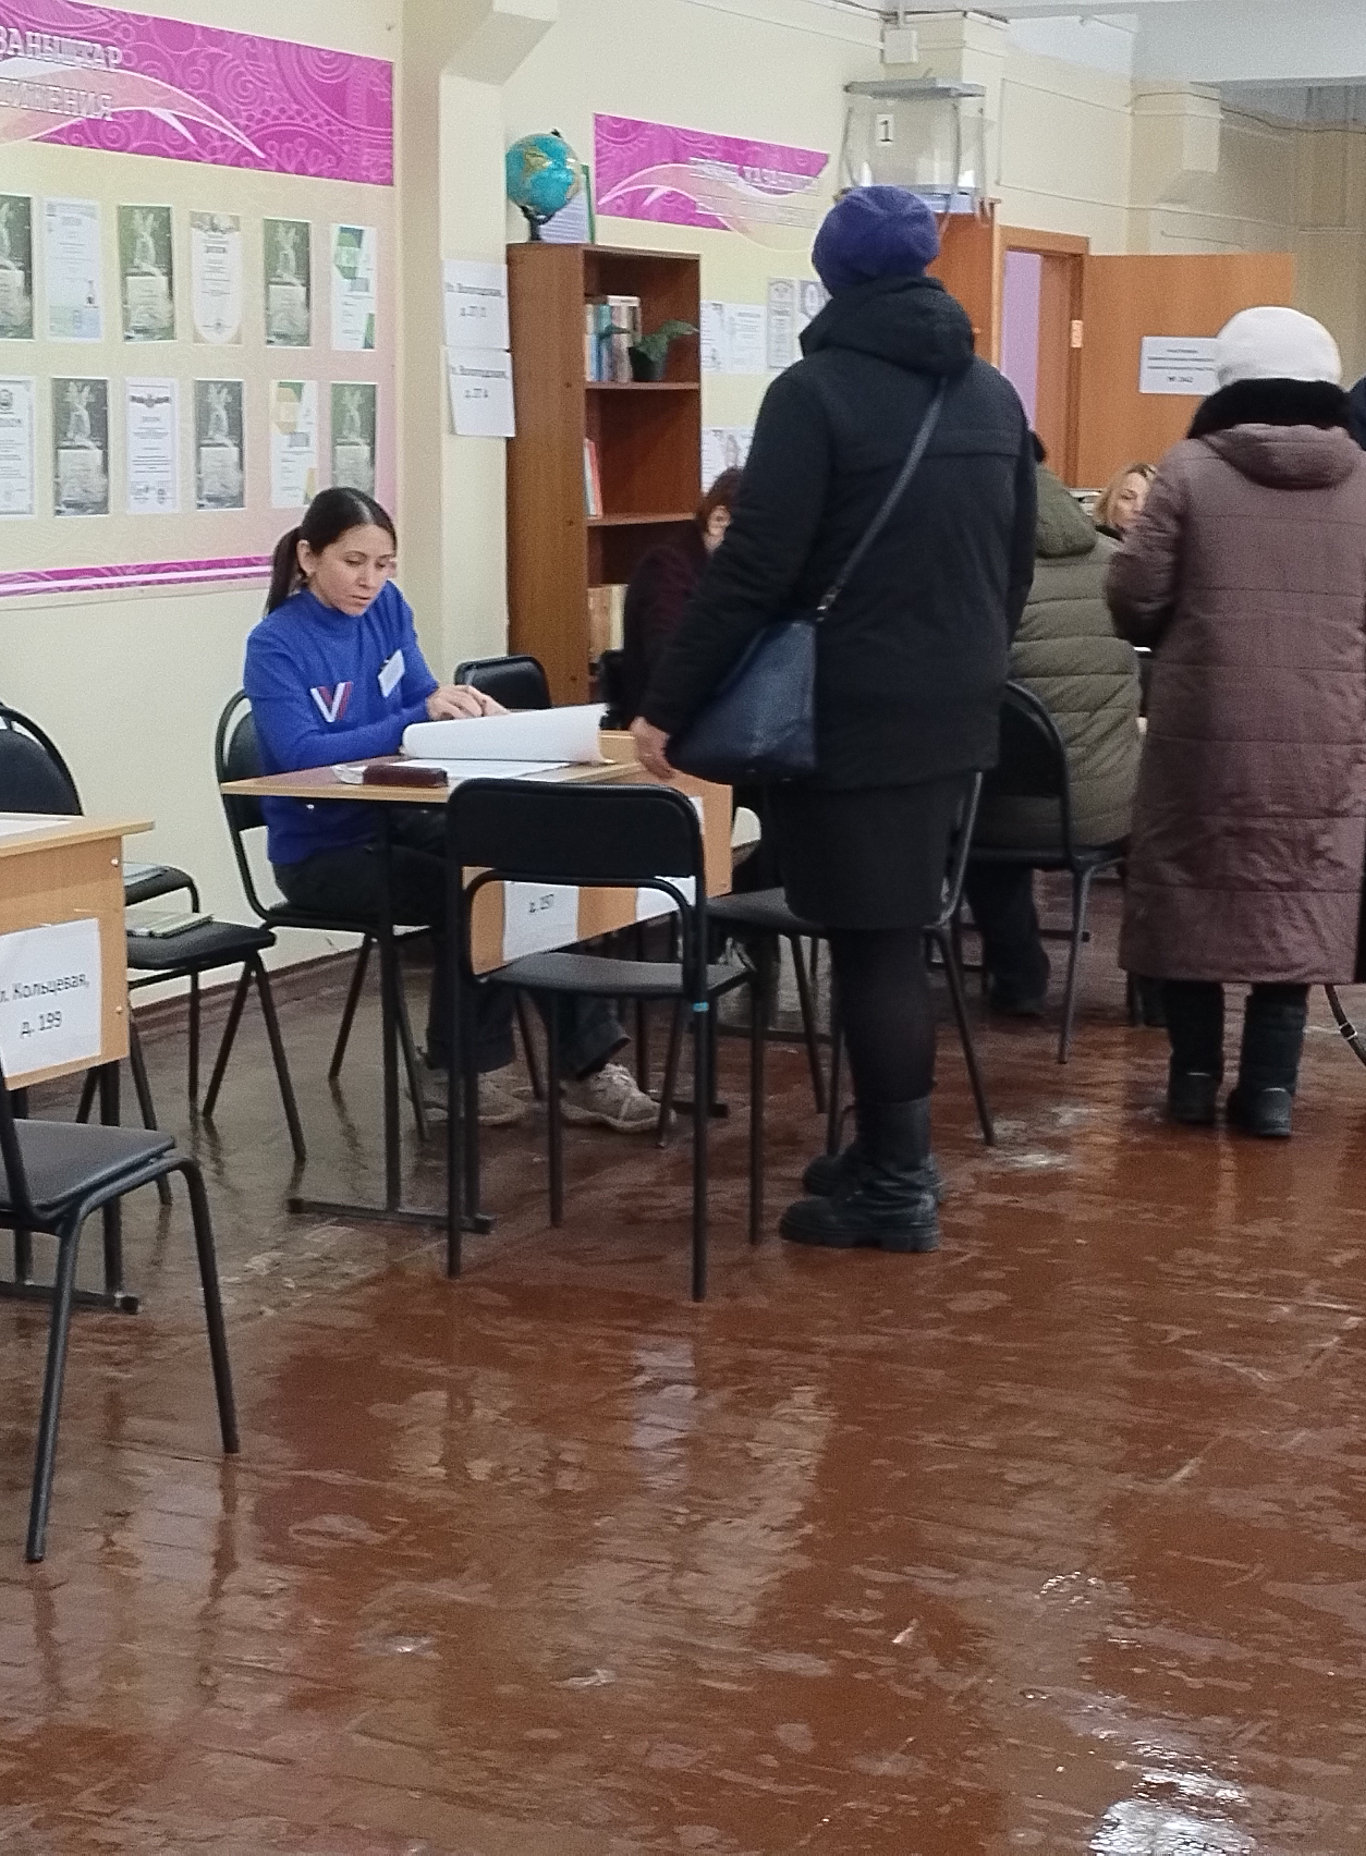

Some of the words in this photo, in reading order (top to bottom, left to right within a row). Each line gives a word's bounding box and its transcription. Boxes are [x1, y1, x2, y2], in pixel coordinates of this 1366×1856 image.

[879, 119, 893, 142] 1
[12, 973, 90, 1001] Кольцевая,
[39, 1010, 63, 1031] 199
